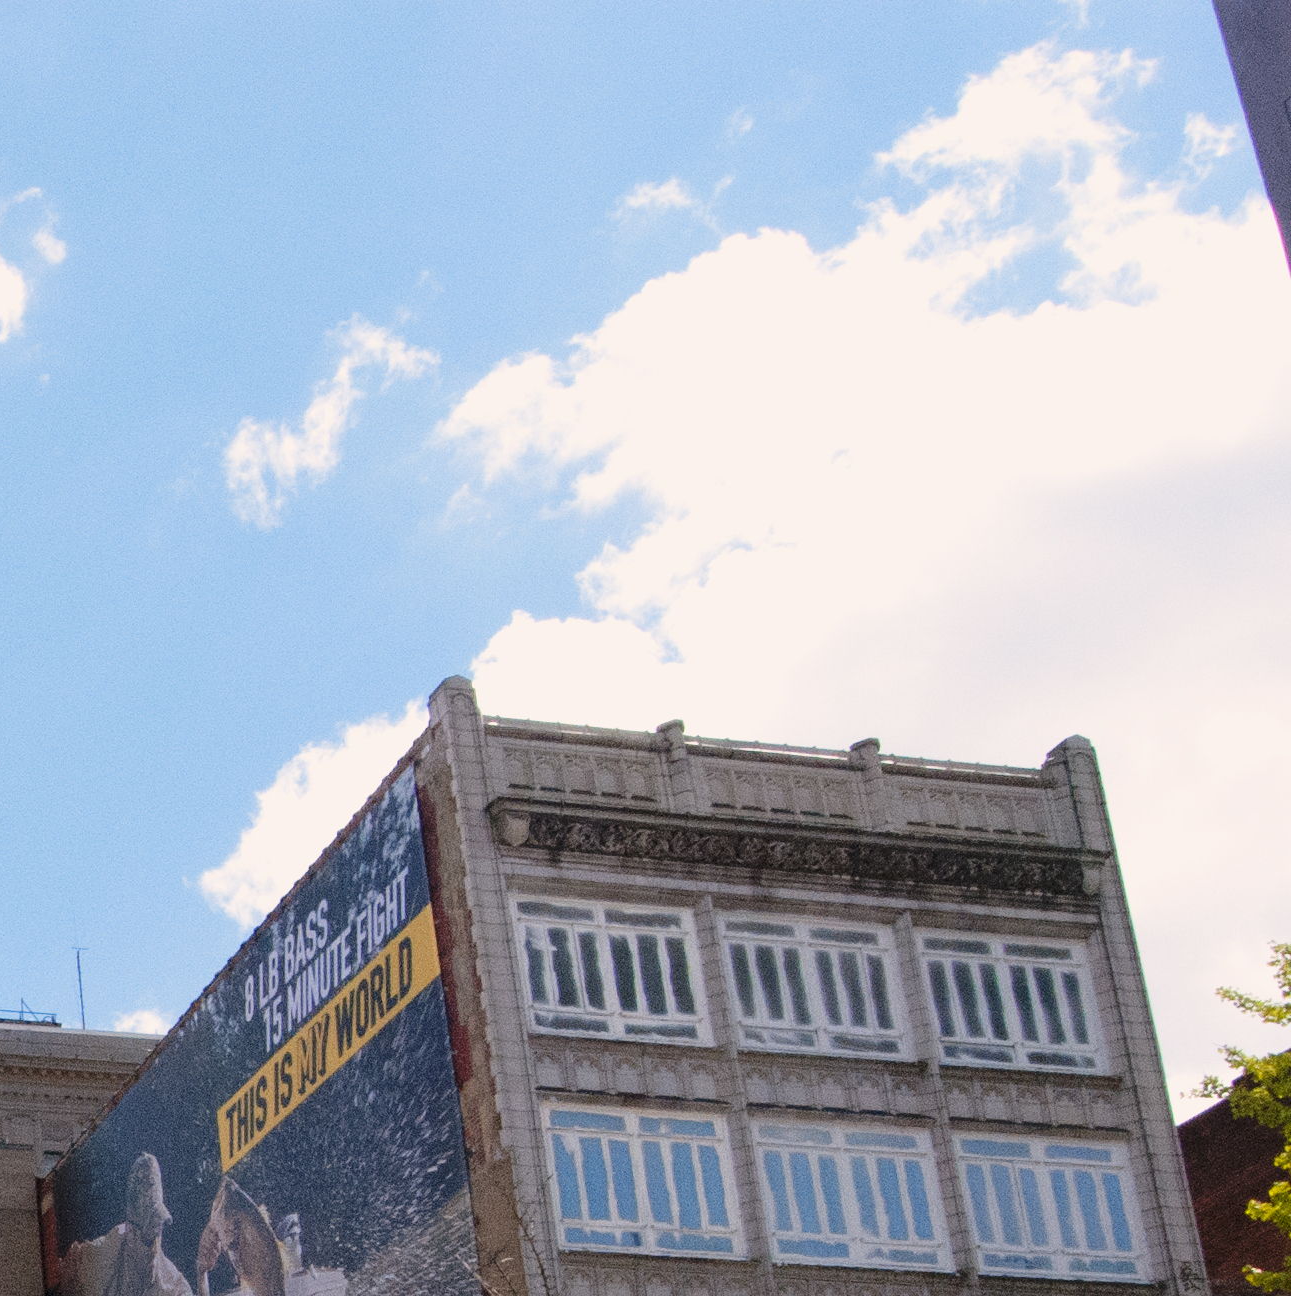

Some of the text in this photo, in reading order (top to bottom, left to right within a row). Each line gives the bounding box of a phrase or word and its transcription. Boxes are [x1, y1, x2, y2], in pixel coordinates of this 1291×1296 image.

[225, 936, 413, 1160] THIS IS MY WORLD
[244, 899, 329, 1022] 8 LB BASS
[263, 866, 409, 1053] 15 MINUTE FIGHT
